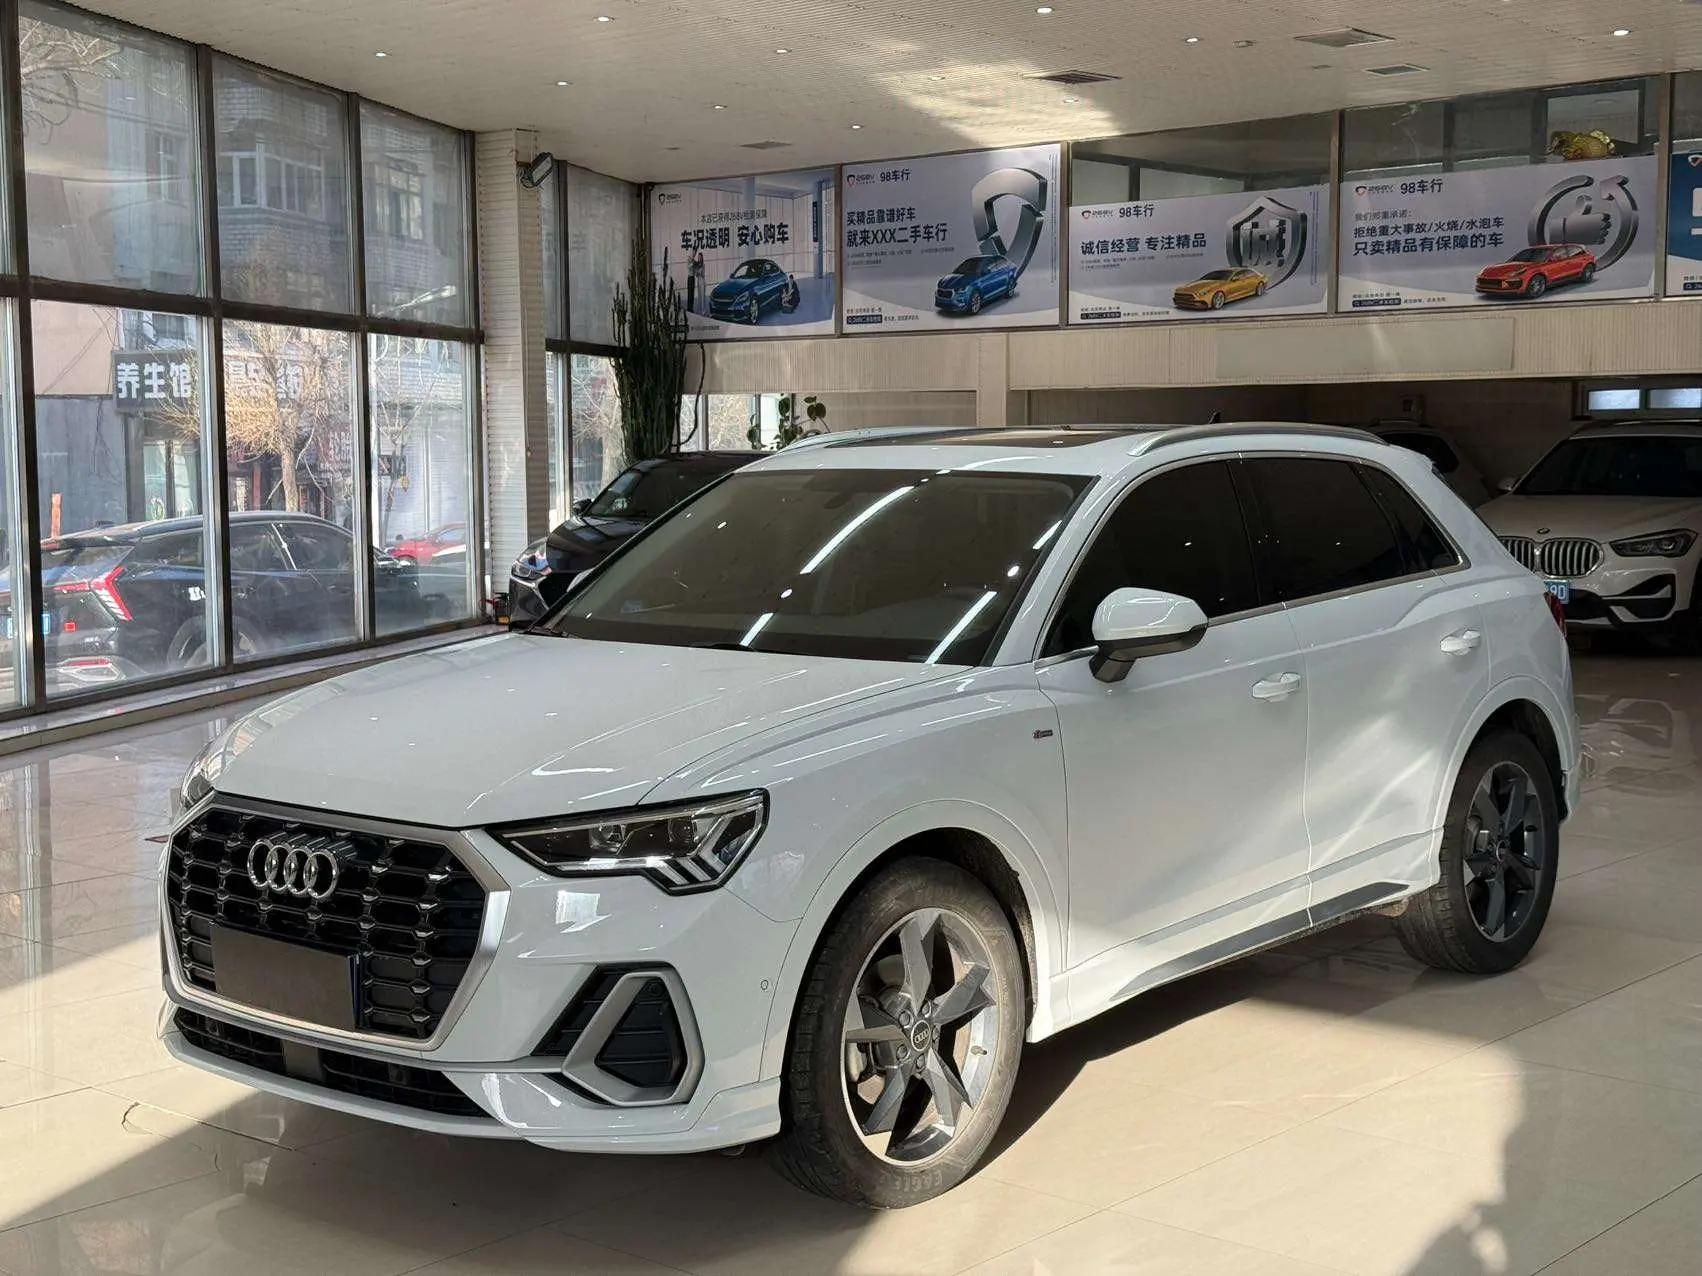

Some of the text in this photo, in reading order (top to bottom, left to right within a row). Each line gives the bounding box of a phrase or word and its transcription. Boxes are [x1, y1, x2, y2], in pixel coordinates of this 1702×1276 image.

[880, 169, 911, 182] 98车行
[1400, 179, 1443, 195] 98车行
[847, 206, 916, 226] 买精品靠谱好车
[1119, 204, 1154, 218] 98车行
[681, 227, 730, 250] 车况透明
[737, 222, 789, 247] 安心购车
[846, 222, 948, 248] 就来XXX二手车行
[1354, 216, 1504, 239] 拒绝重大事故/火烧/水泡车
[1081, 232, 1207, 256] 诚信经营 专注精品
[1353, 231, 1504, 256] 只卖精品有保障的车
[117, 362, 192, 400] 养生馆
